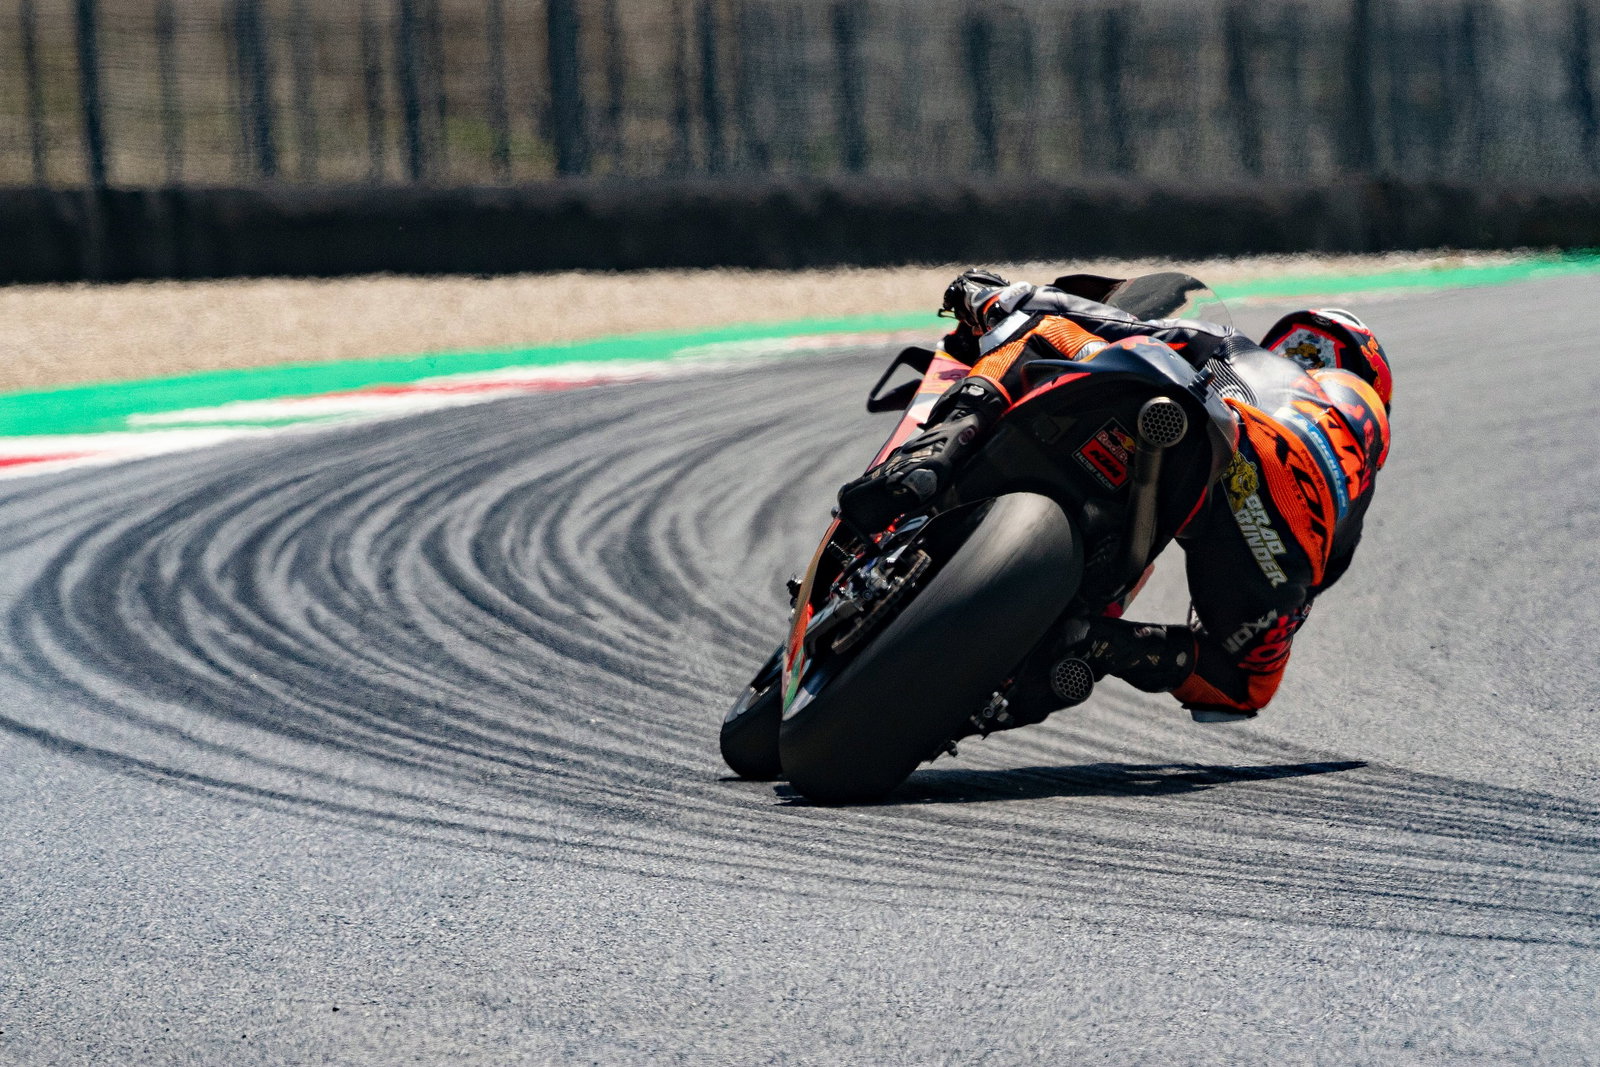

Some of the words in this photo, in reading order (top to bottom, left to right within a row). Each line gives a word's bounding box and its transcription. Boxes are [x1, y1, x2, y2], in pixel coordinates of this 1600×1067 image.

[1312, 430, 1346, 507] MICHELIN
[1234, 508, 1289, 588] BINDER
[1246, 493, 1287, 554] BRAD
